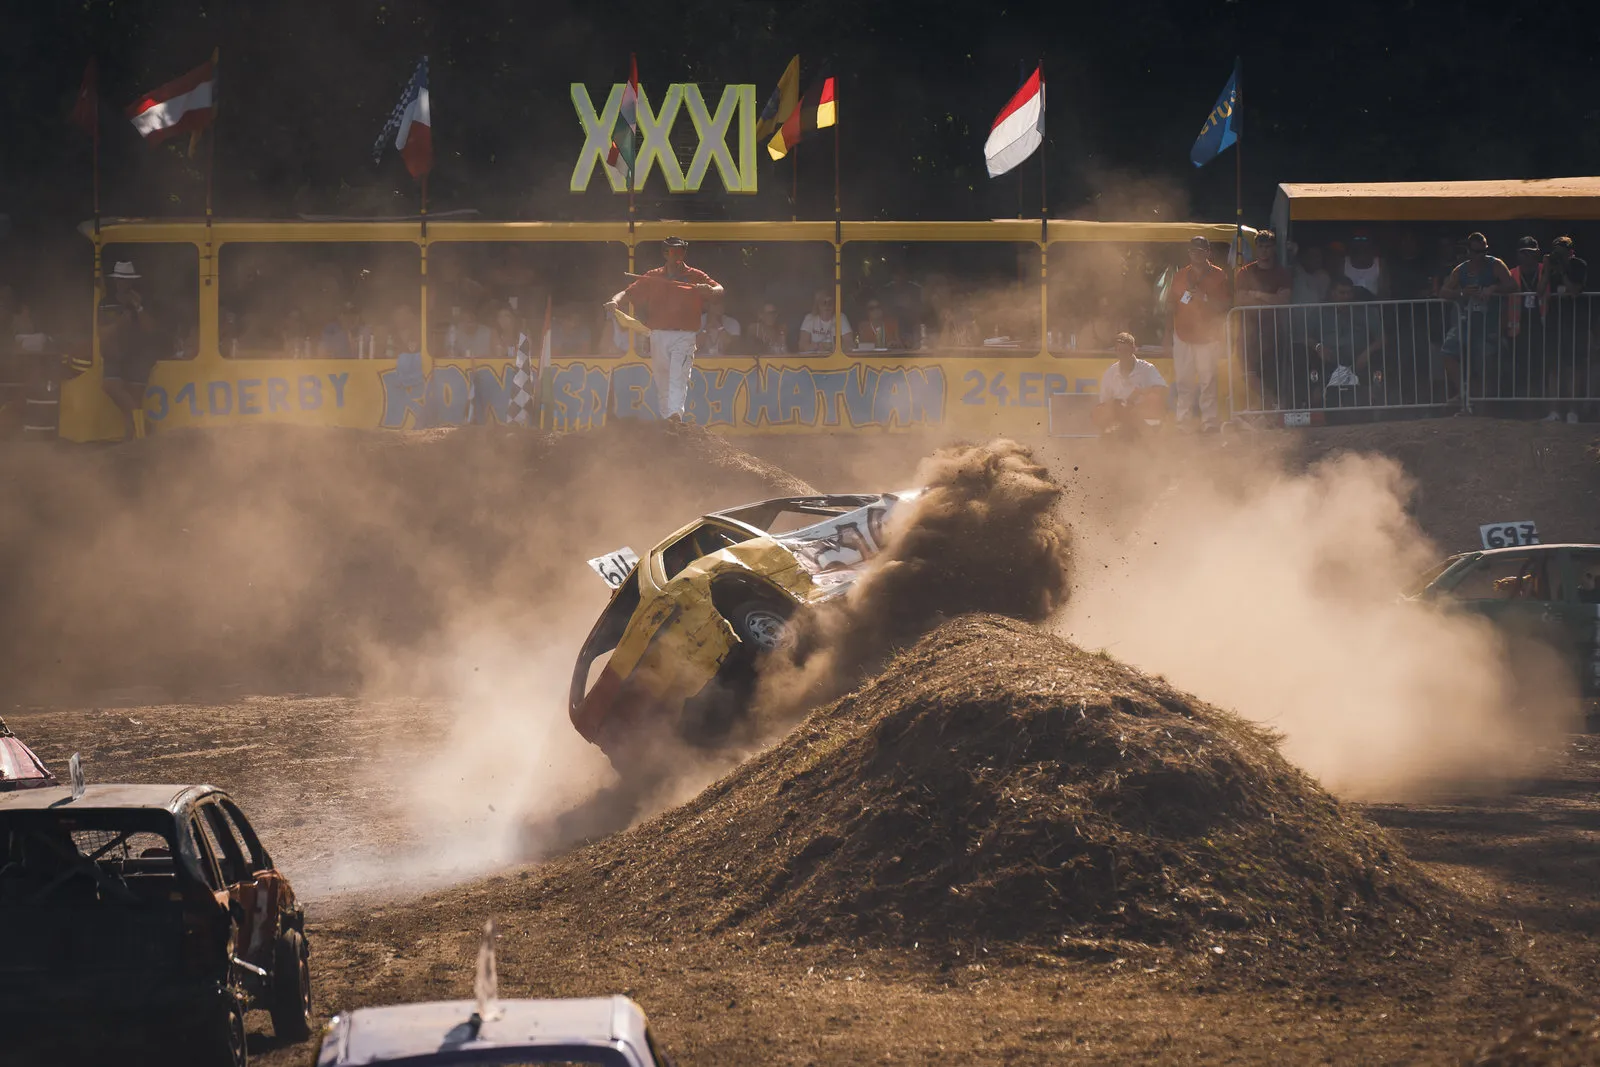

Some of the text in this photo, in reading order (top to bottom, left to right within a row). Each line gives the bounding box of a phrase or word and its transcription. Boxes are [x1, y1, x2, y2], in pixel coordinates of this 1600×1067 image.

[571, 83, 757, 193] XXXI
[377, 362, 947, 431] RONSDEBY HATVAN
[1486, 524, 1540, 548] 697
